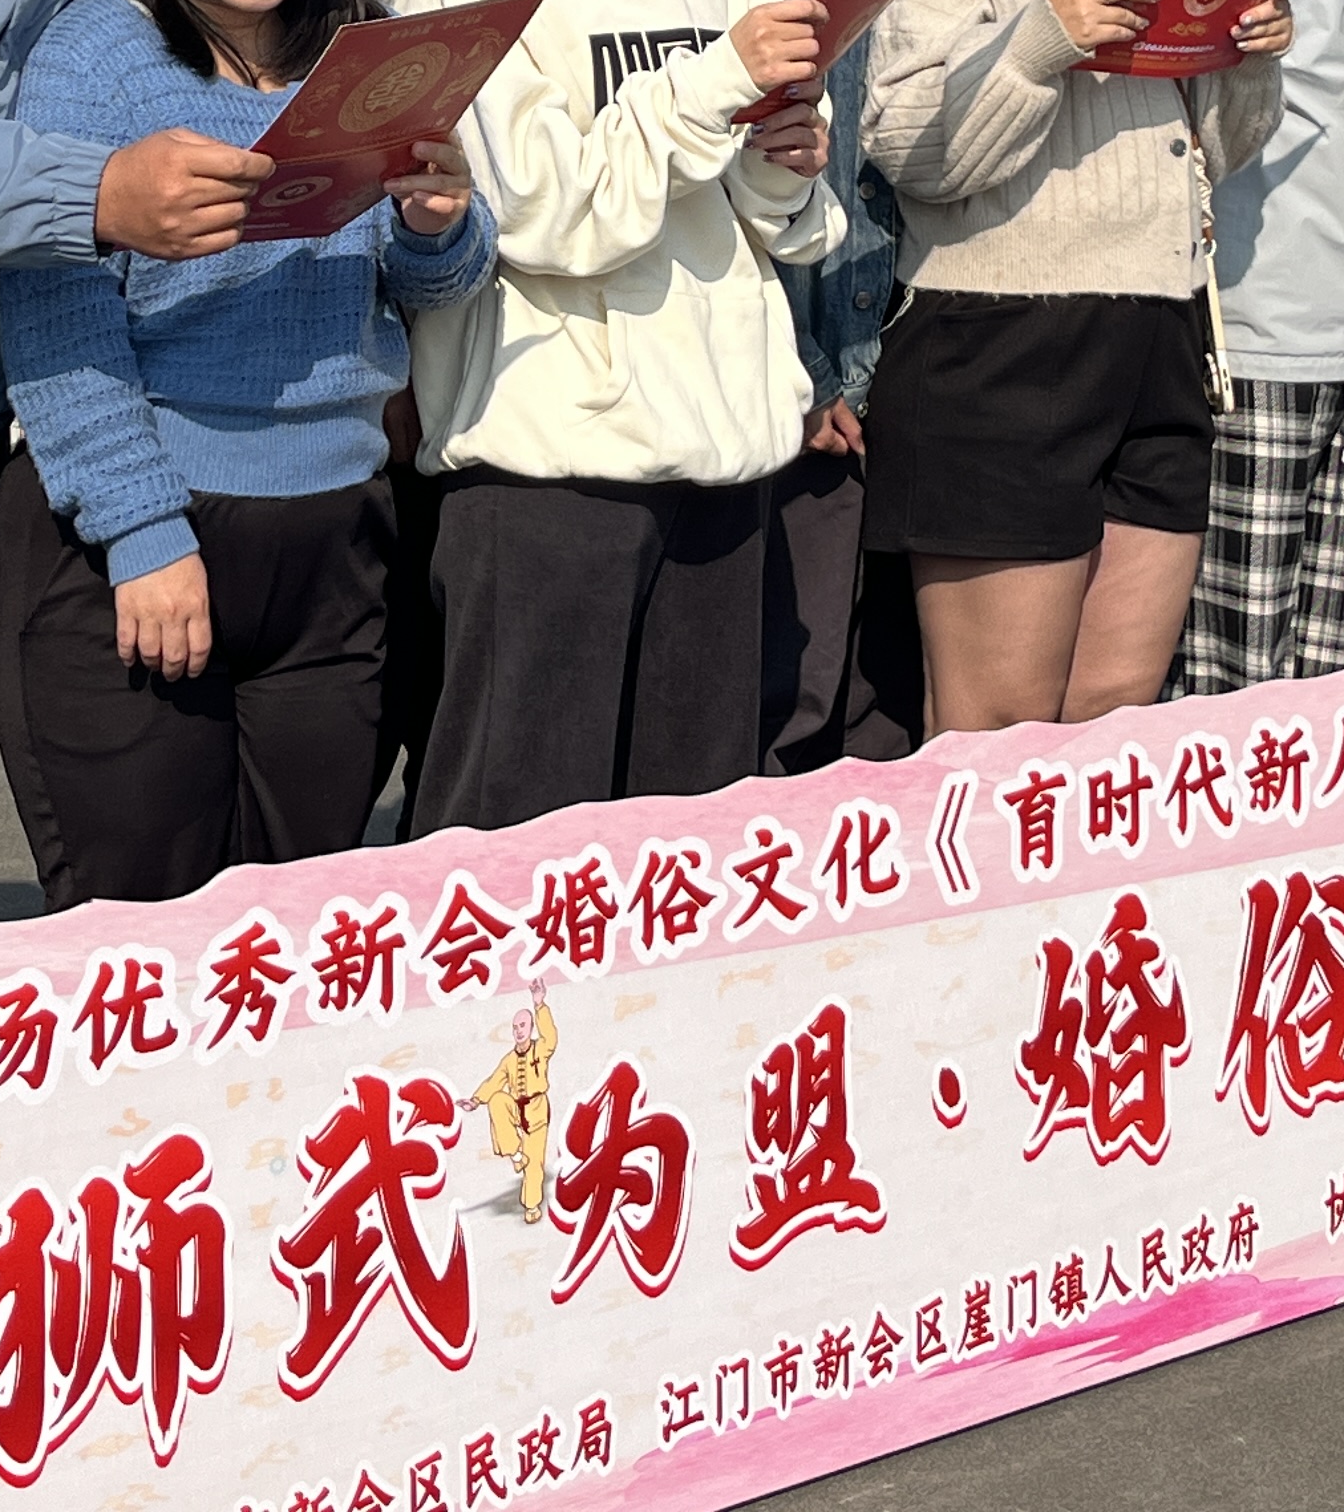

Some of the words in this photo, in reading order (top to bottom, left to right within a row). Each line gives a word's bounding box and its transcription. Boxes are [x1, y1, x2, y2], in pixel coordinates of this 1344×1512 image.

[660, 1202, 1260, 1440] 江门市新会区崖门镇人民政府
